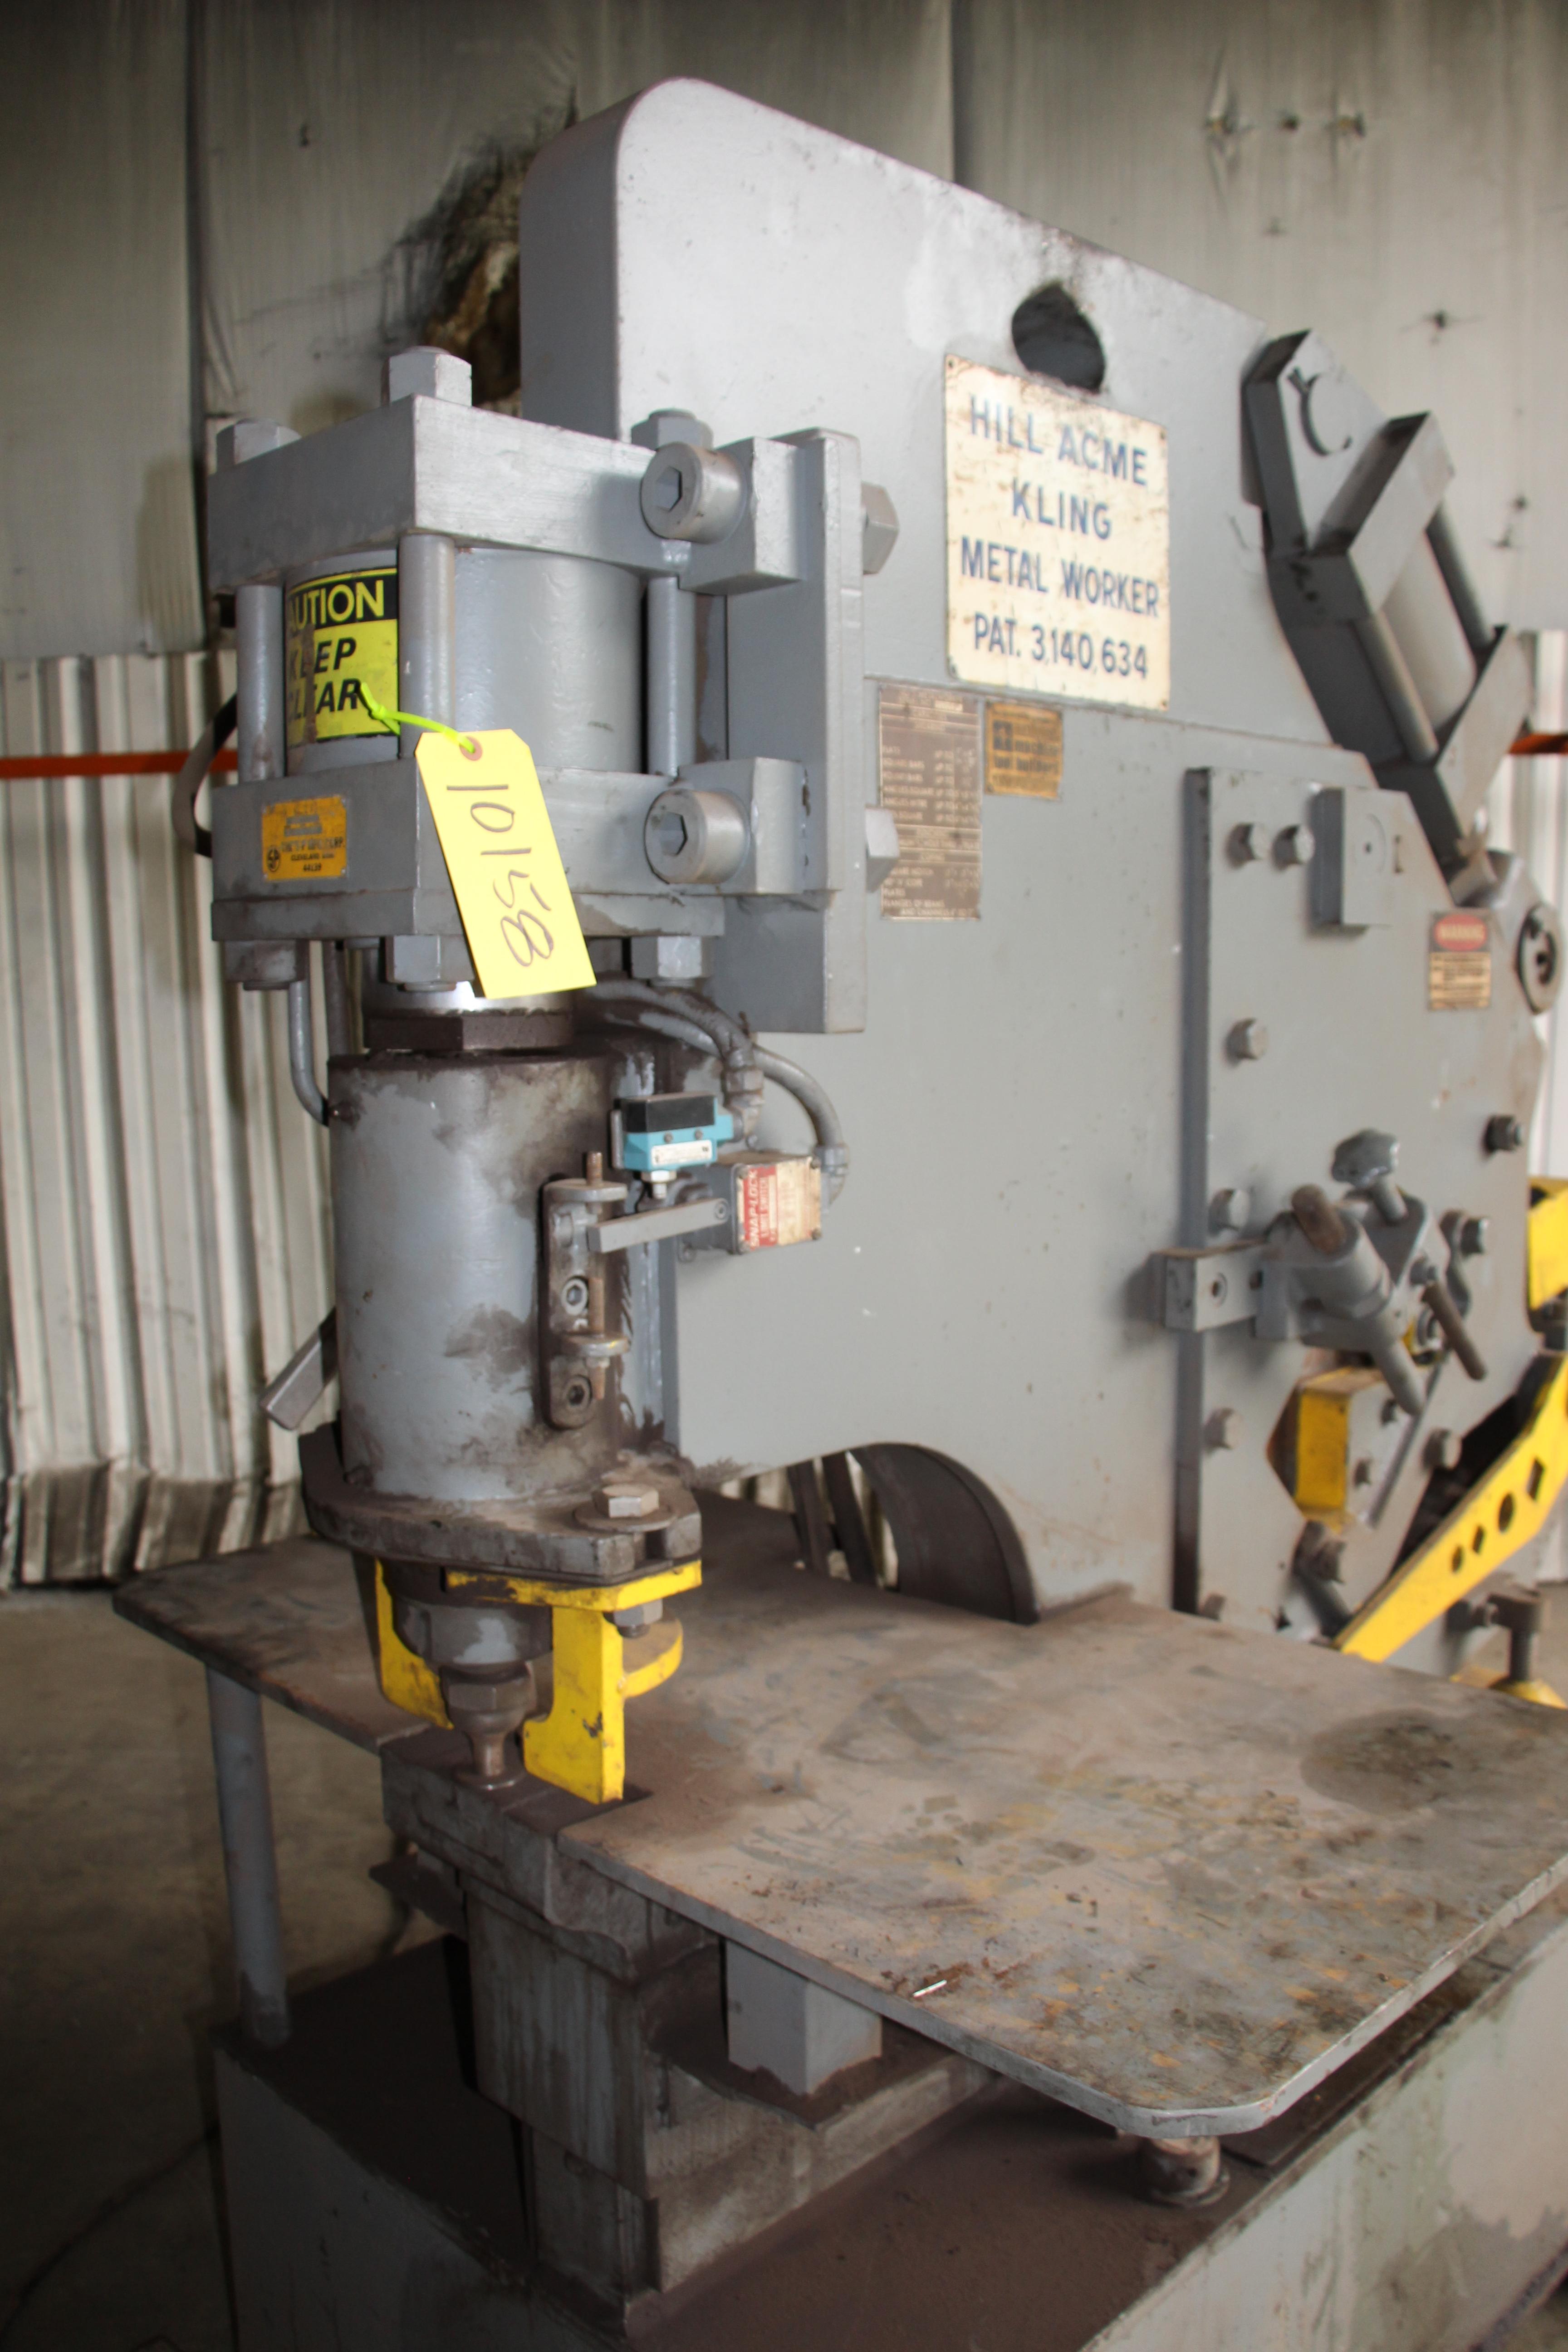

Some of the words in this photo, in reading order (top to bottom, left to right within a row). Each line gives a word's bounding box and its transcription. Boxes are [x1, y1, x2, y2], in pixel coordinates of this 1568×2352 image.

[969, 395, 1044, 455] HILL
[1058, 424, 1148, 486] ACME
[1012, 477, 1112, 540] KLING
[961, 536, 1049, 593] METAL
[1062, 558, 1159, 617] WORKER
[974, 612, 1021, 658] PAT.
[446, 784, 554, 967] 10158
